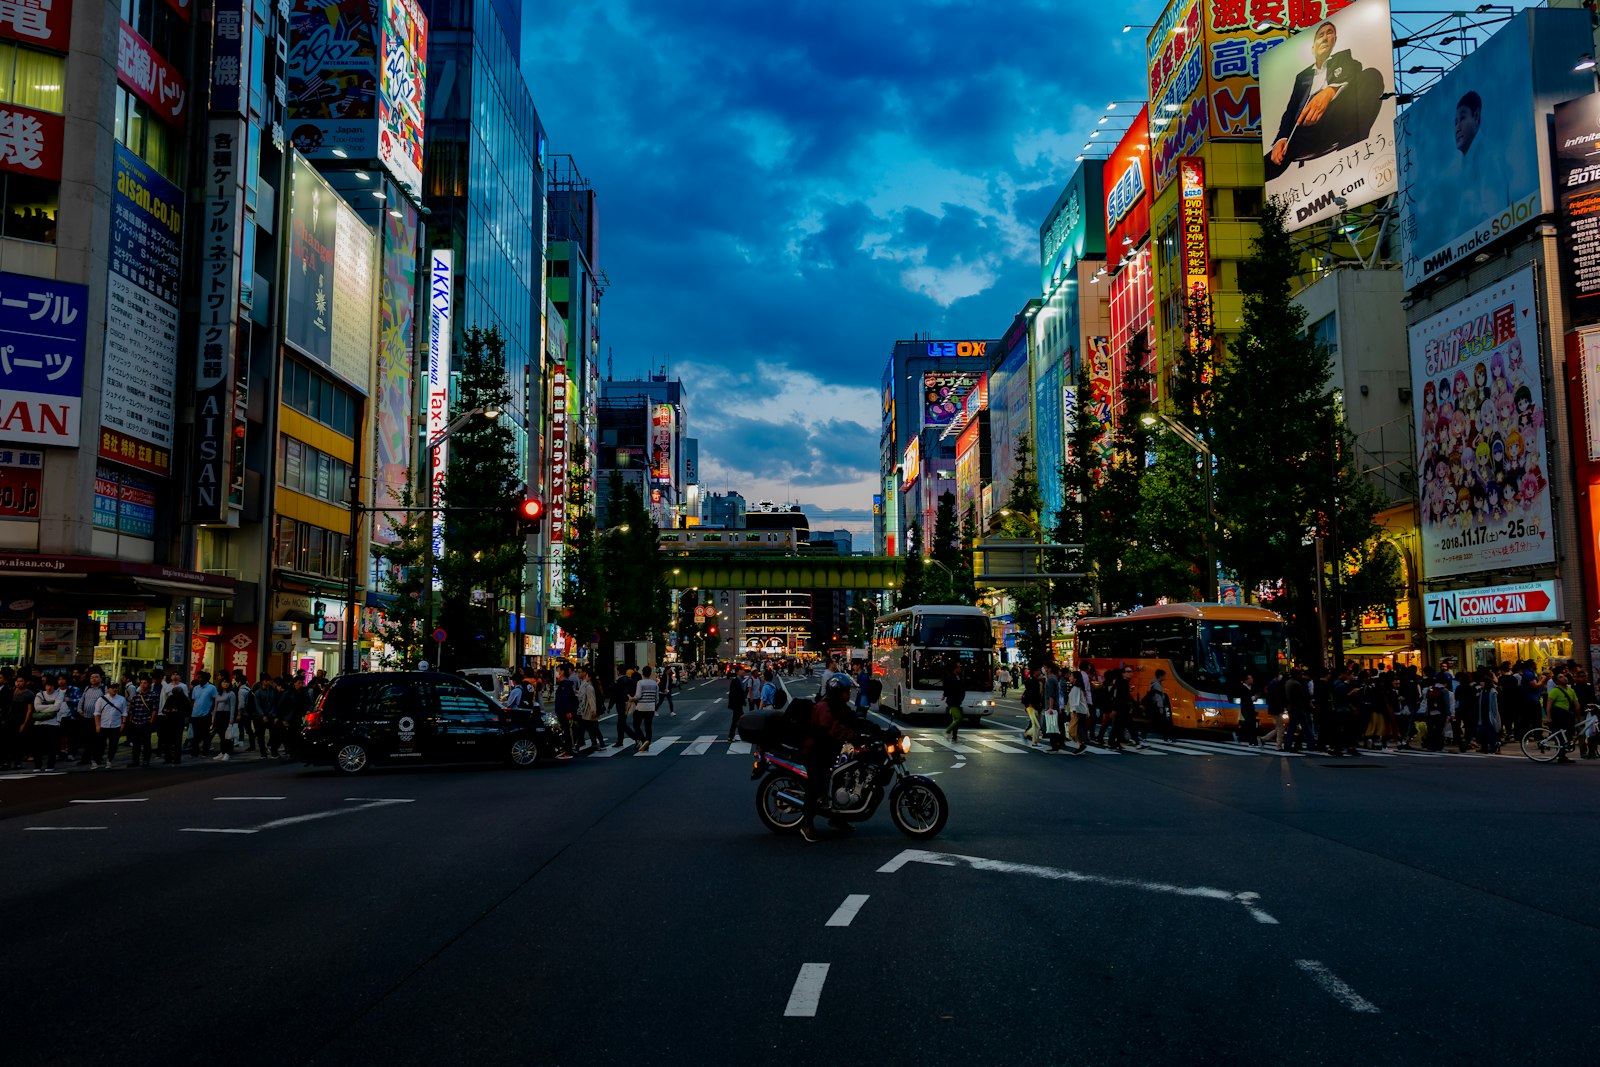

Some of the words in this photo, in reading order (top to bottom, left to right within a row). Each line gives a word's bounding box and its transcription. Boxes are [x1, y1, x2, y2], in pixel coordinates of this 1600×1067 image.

[118, 28, 186, 116] 配線パーツ
[117, 169, 181, 235] aisan.co.jp
[1108, 160, 1144, 232] SEGA
[1296, 177, 1365, 223] DMMcom
[1492, 195, 1537, 232] solar
[1186, 233, 1204, 241] アイドル
[1189, 258, 1205, 266] ホビー
[0, 292, 78, 326] ーブル
[433, 257, 449, 319] AKKY
[430, 304, 440, 386] INTERNATIONAL
[197, 395, 220, 507] AISAN
[431, 389, 446, 467] Tax-fee
[1428, 593, 1457, 624] ZIN
[1461, 597, 1503, 615] COMIC
[1506, 595, 1526, 612] ZIN
[1460, 616, 1496, 624] Akihabara
